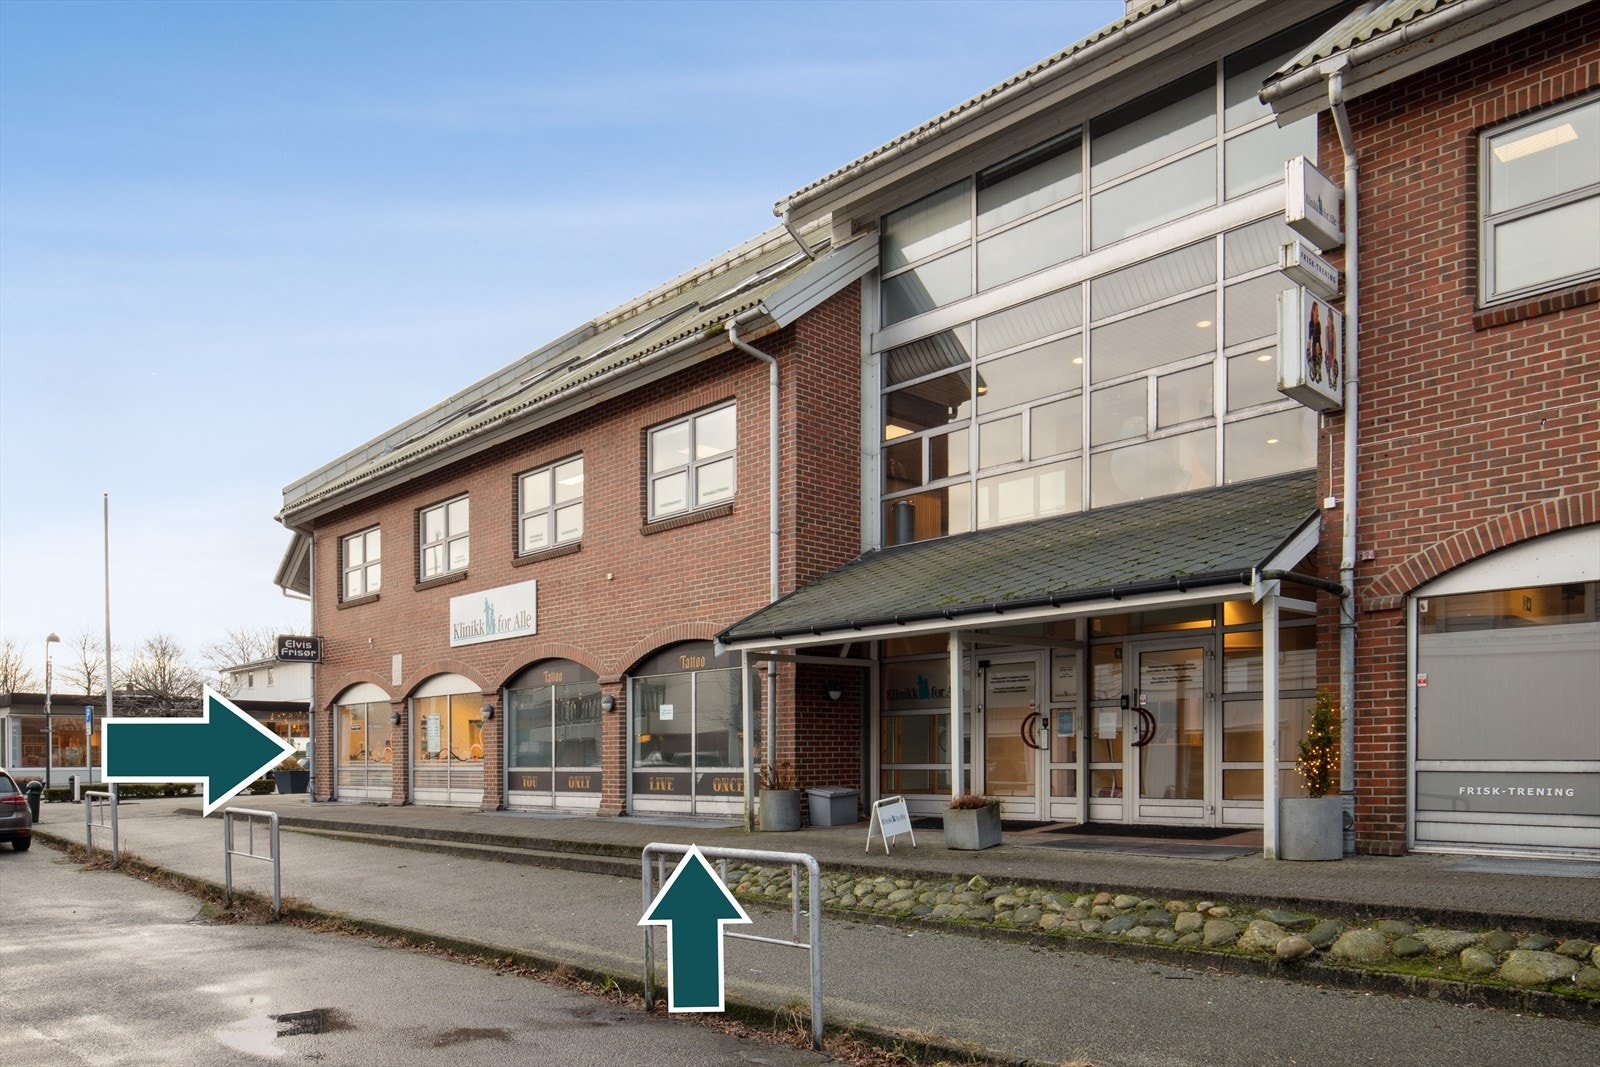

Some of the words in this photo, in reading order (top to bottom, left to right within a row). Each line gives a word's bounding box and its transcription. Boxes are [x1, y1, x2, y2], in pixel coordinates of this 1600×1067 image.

[453, 619, 485, 640] Klinikk
[497, 614, 511, 632] for
[513, 610, 532, 629] Alle
[285, 640, 312, 649] Elvis
[281, 647, 317, 657] Frisør
[931, 685, 945, 698] for
[522, 776, 538, 788] YOU
[568, 776, 591, 789] ONLY
[649, 776, 674, 791] LIVE
[712, 777, 745, 792] ONCE
[1459, 786, 1575, 797] FRISK-TRENING
